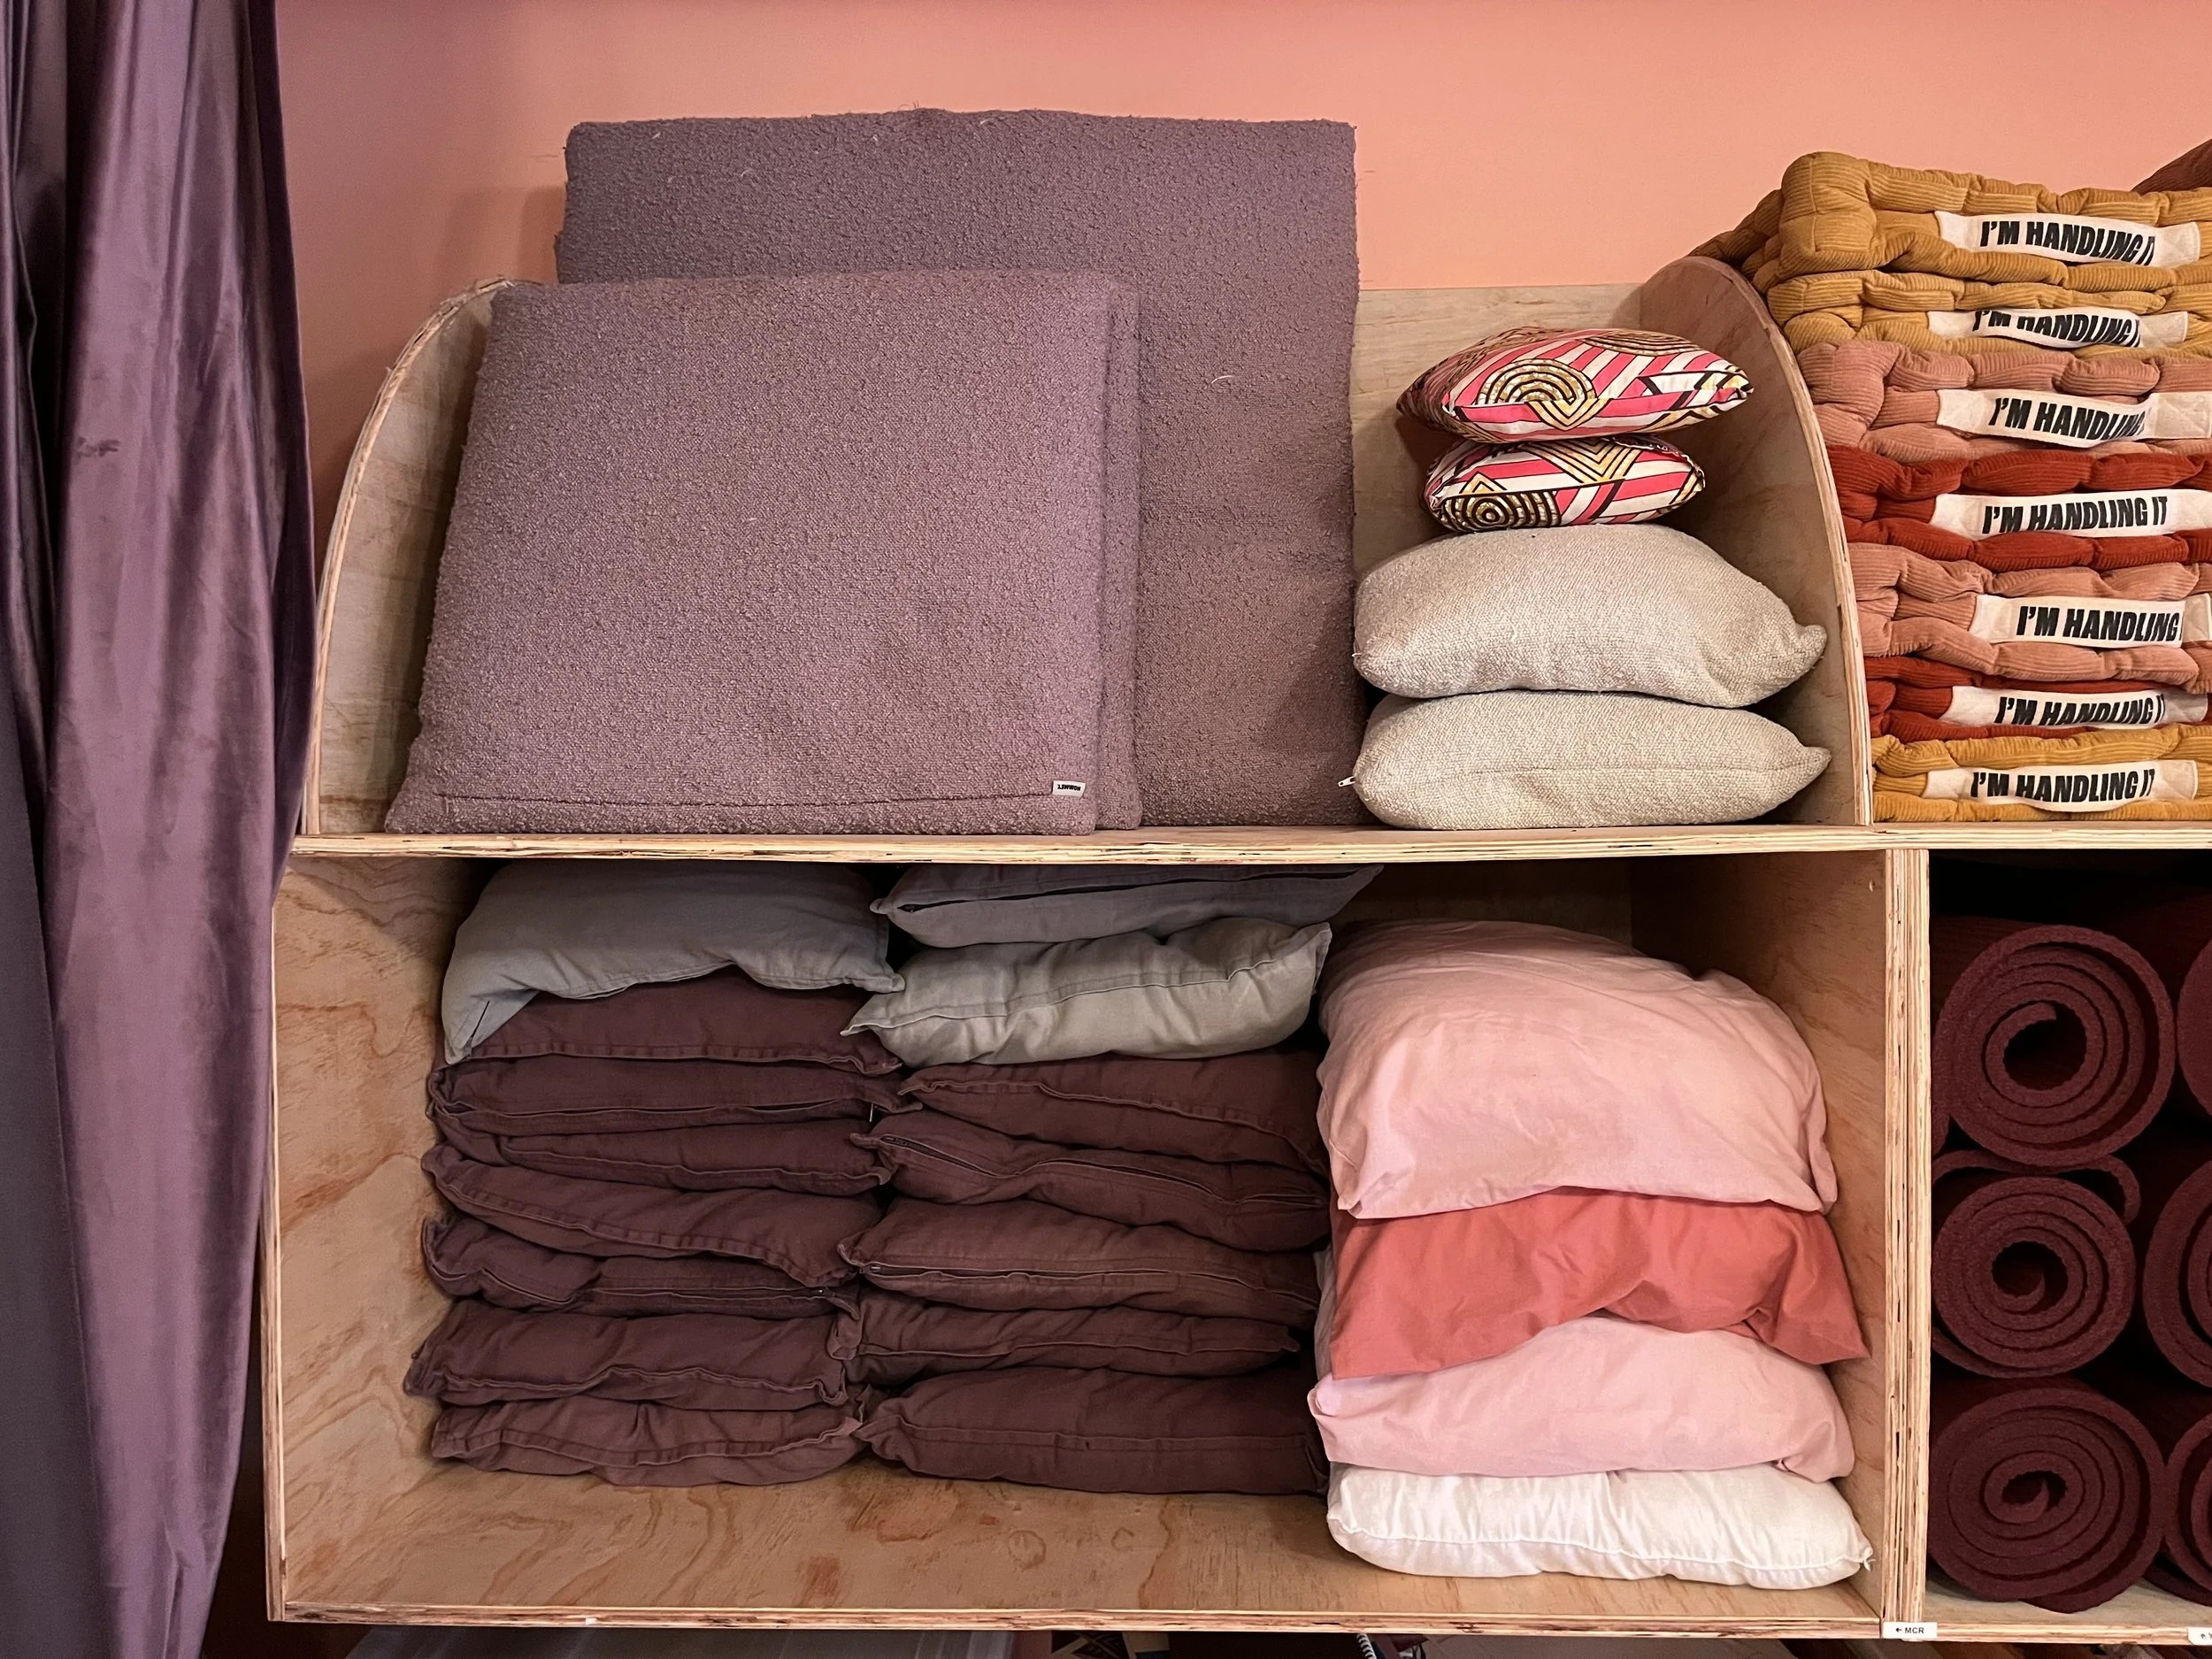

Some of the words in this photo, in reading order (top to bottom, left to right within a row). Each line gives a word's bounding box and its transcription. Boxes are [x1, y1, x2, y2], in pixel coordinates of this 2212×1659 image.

[1980, 220, 2020, 247] I'M
[2025, 221, 2143, 263] HANDLING
[2016, 313, 2132, 344] HANDLING
[1988, 397, 2032, 430] I'M
[1982, 505, 2024, 534] I'M
[2026, 497, 2148, 531] HANDLING
[2152, 495, 2168, 526] IT
[2016, 605, 2060, 636] I'M
[2062, 608, 2180, 641] HANDLING
[1993, 696, 2038, 726] I'M
[2039, 697, 2154, 726] HANDLING
[1970, 772, 2009, 797] I'M
[2015, 771, 2139, 803] HANDLING
